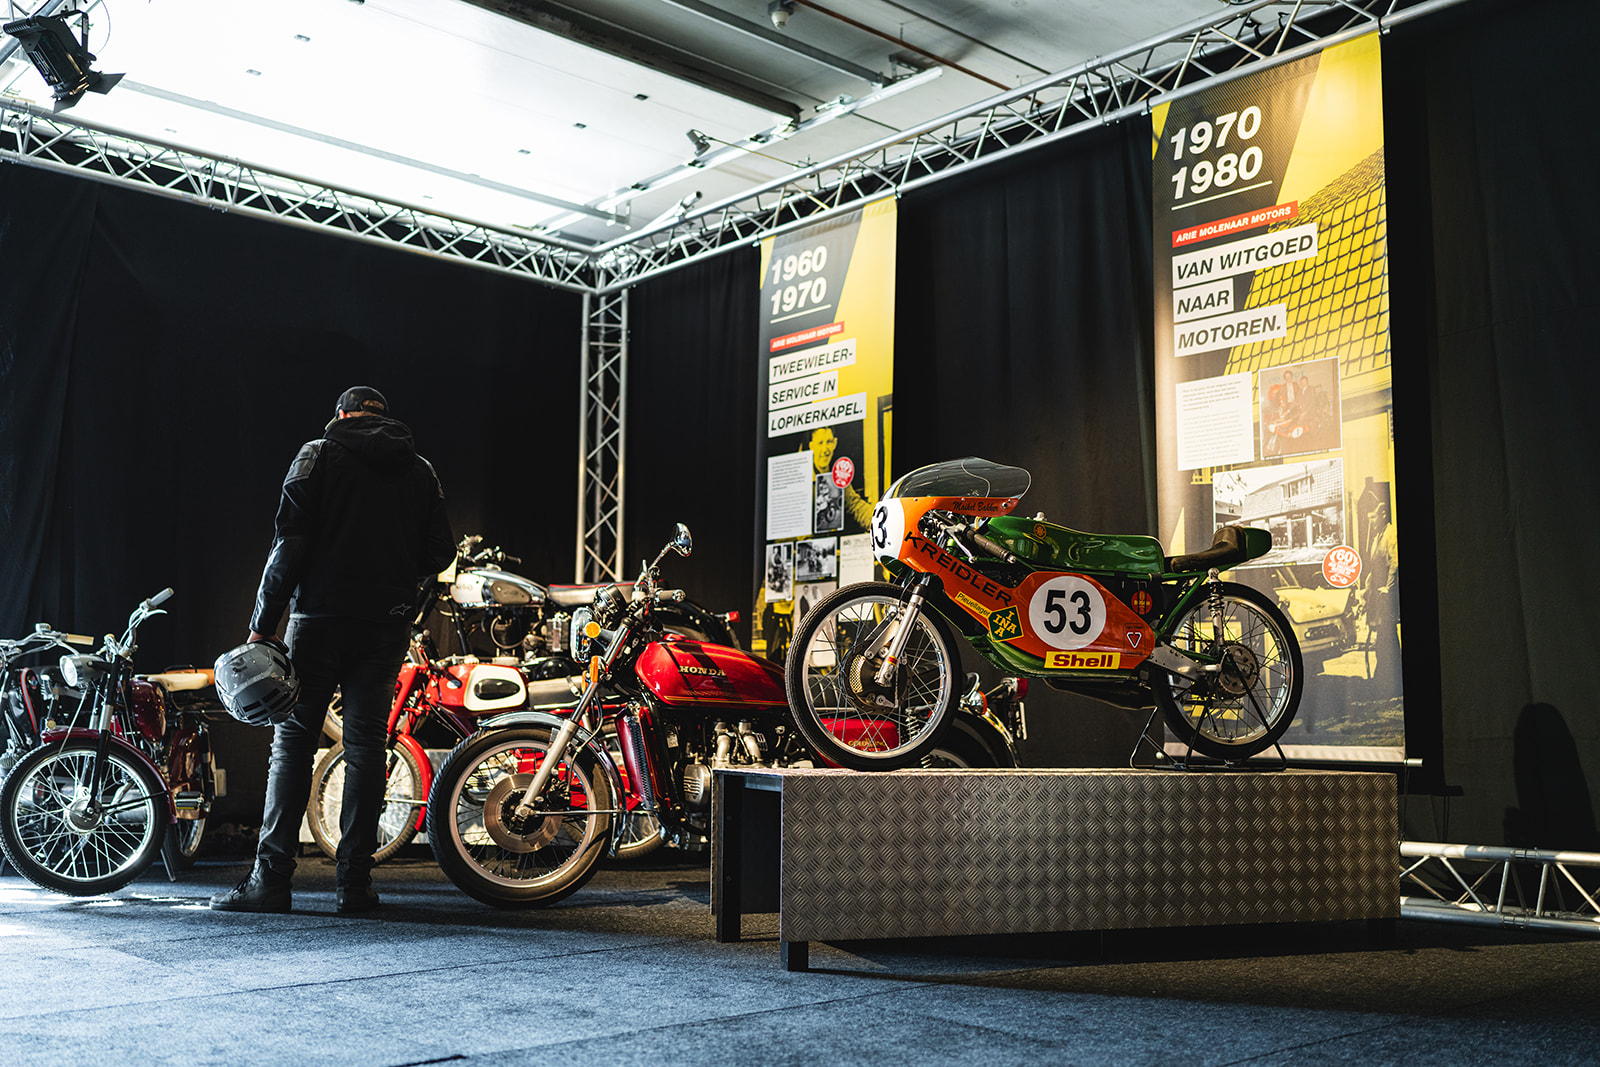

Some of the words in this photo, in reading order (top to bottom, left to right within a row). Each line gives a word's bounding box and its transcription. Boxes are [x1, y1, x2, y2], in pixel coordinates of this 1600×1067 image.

[1170, 105, 1262, 161] 1970
[1171, 146, 1263, 200] 1980
[1176, 230, 1197, 243] ARIE
[1199, 217, 1249, 237] MOLENAAR
[1250, 206, 1291, 224] MOTORS
[771, 245, 828, 285] 1960
[1177, 258, 1213, 280] VAN
[1220, 234, 1314, 270] WITGOED
[771, 277, 827, 315] 1970
[1177, 290, 1230, 315] NAAR
[1178, 315, 1281, 349] MOTOREN.
[773, 348, 853, 377] TWEEWIELER-
[771, 382, 820, 404] SERVICE
[823, 378, 836, 393] IN
[771, 402, 863, 431] LOPIKERKAPEL.
[904, 532, 1012, 608] KREIDLER
[1043, 589, 1092, 635] 53
[679, 665, 726, 676] HONDA
[1053, 654, 1113, 668] Shell
